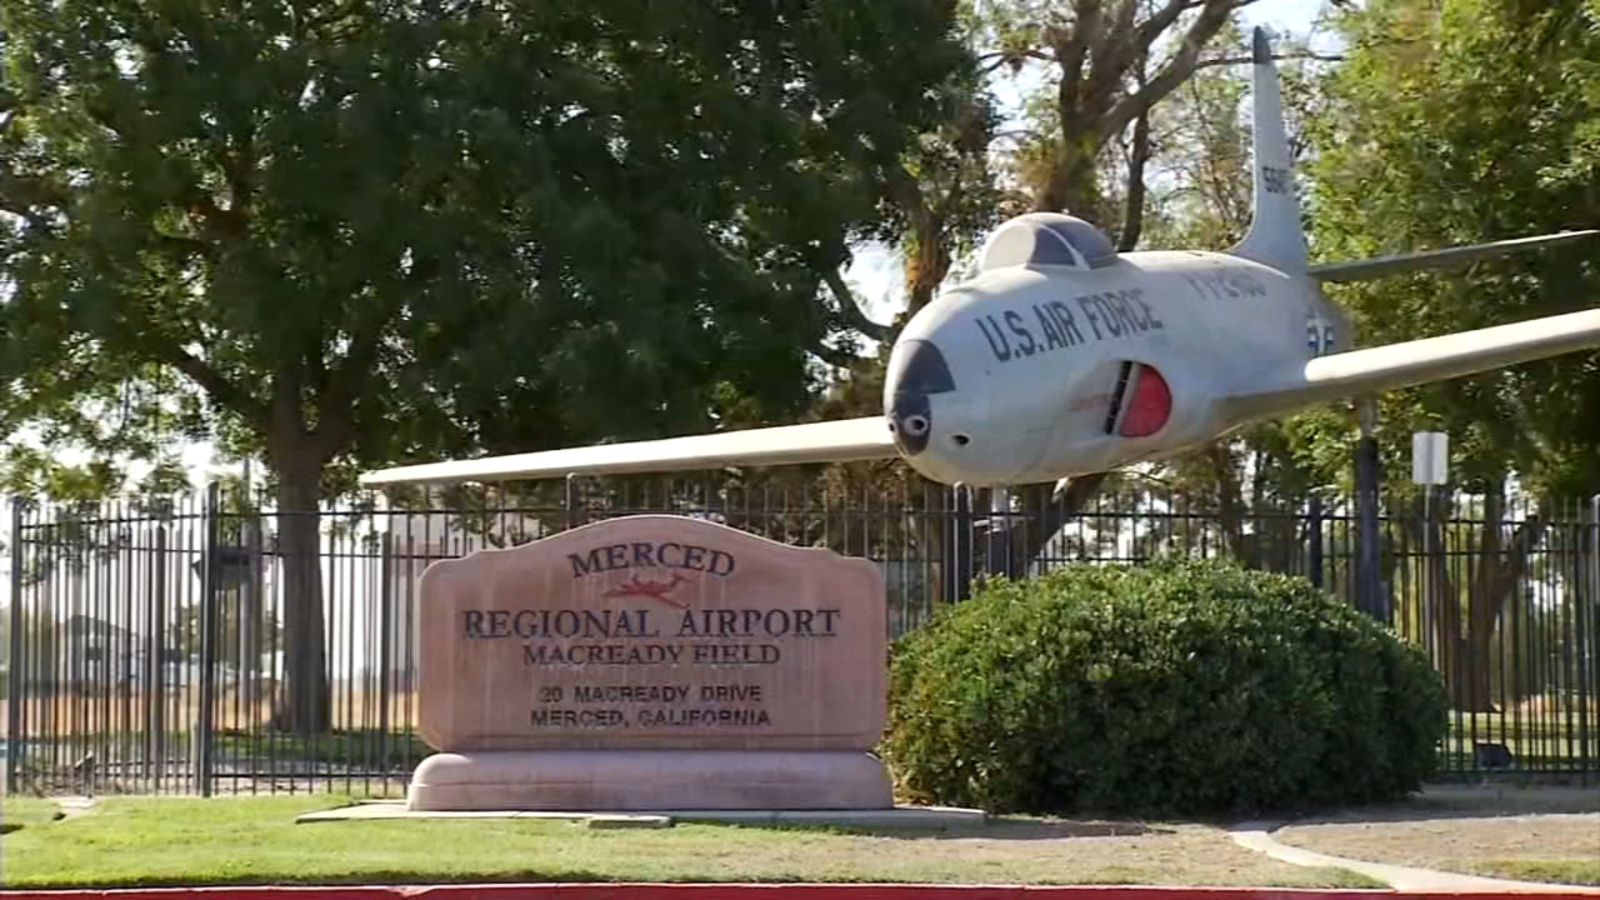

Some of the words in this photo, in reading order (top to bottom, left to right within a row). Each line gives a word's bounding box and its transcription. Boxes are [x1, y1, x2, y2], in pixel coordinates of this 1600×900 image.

[974, 310, 1046, 362] U.S.
[1031, 301, 1085, 351] AIR
[1073, 289, 1164, 341] FORCE
[568, 541, 736, 578] MERCED
[464, 610, 661, 638] REGIONAL
[676, 609, 841, 637] AIRPORT
[523, 644, 684, 666] MACREADY
[693, 645, 781, 665] FIELD
[574, 686, 690, 702] MACREADY
[701, 685, 762, 701] DRIVE
[530, 710, 630, 728] MERCED,
[638, 709, 771, 727] CALIFORNIA
